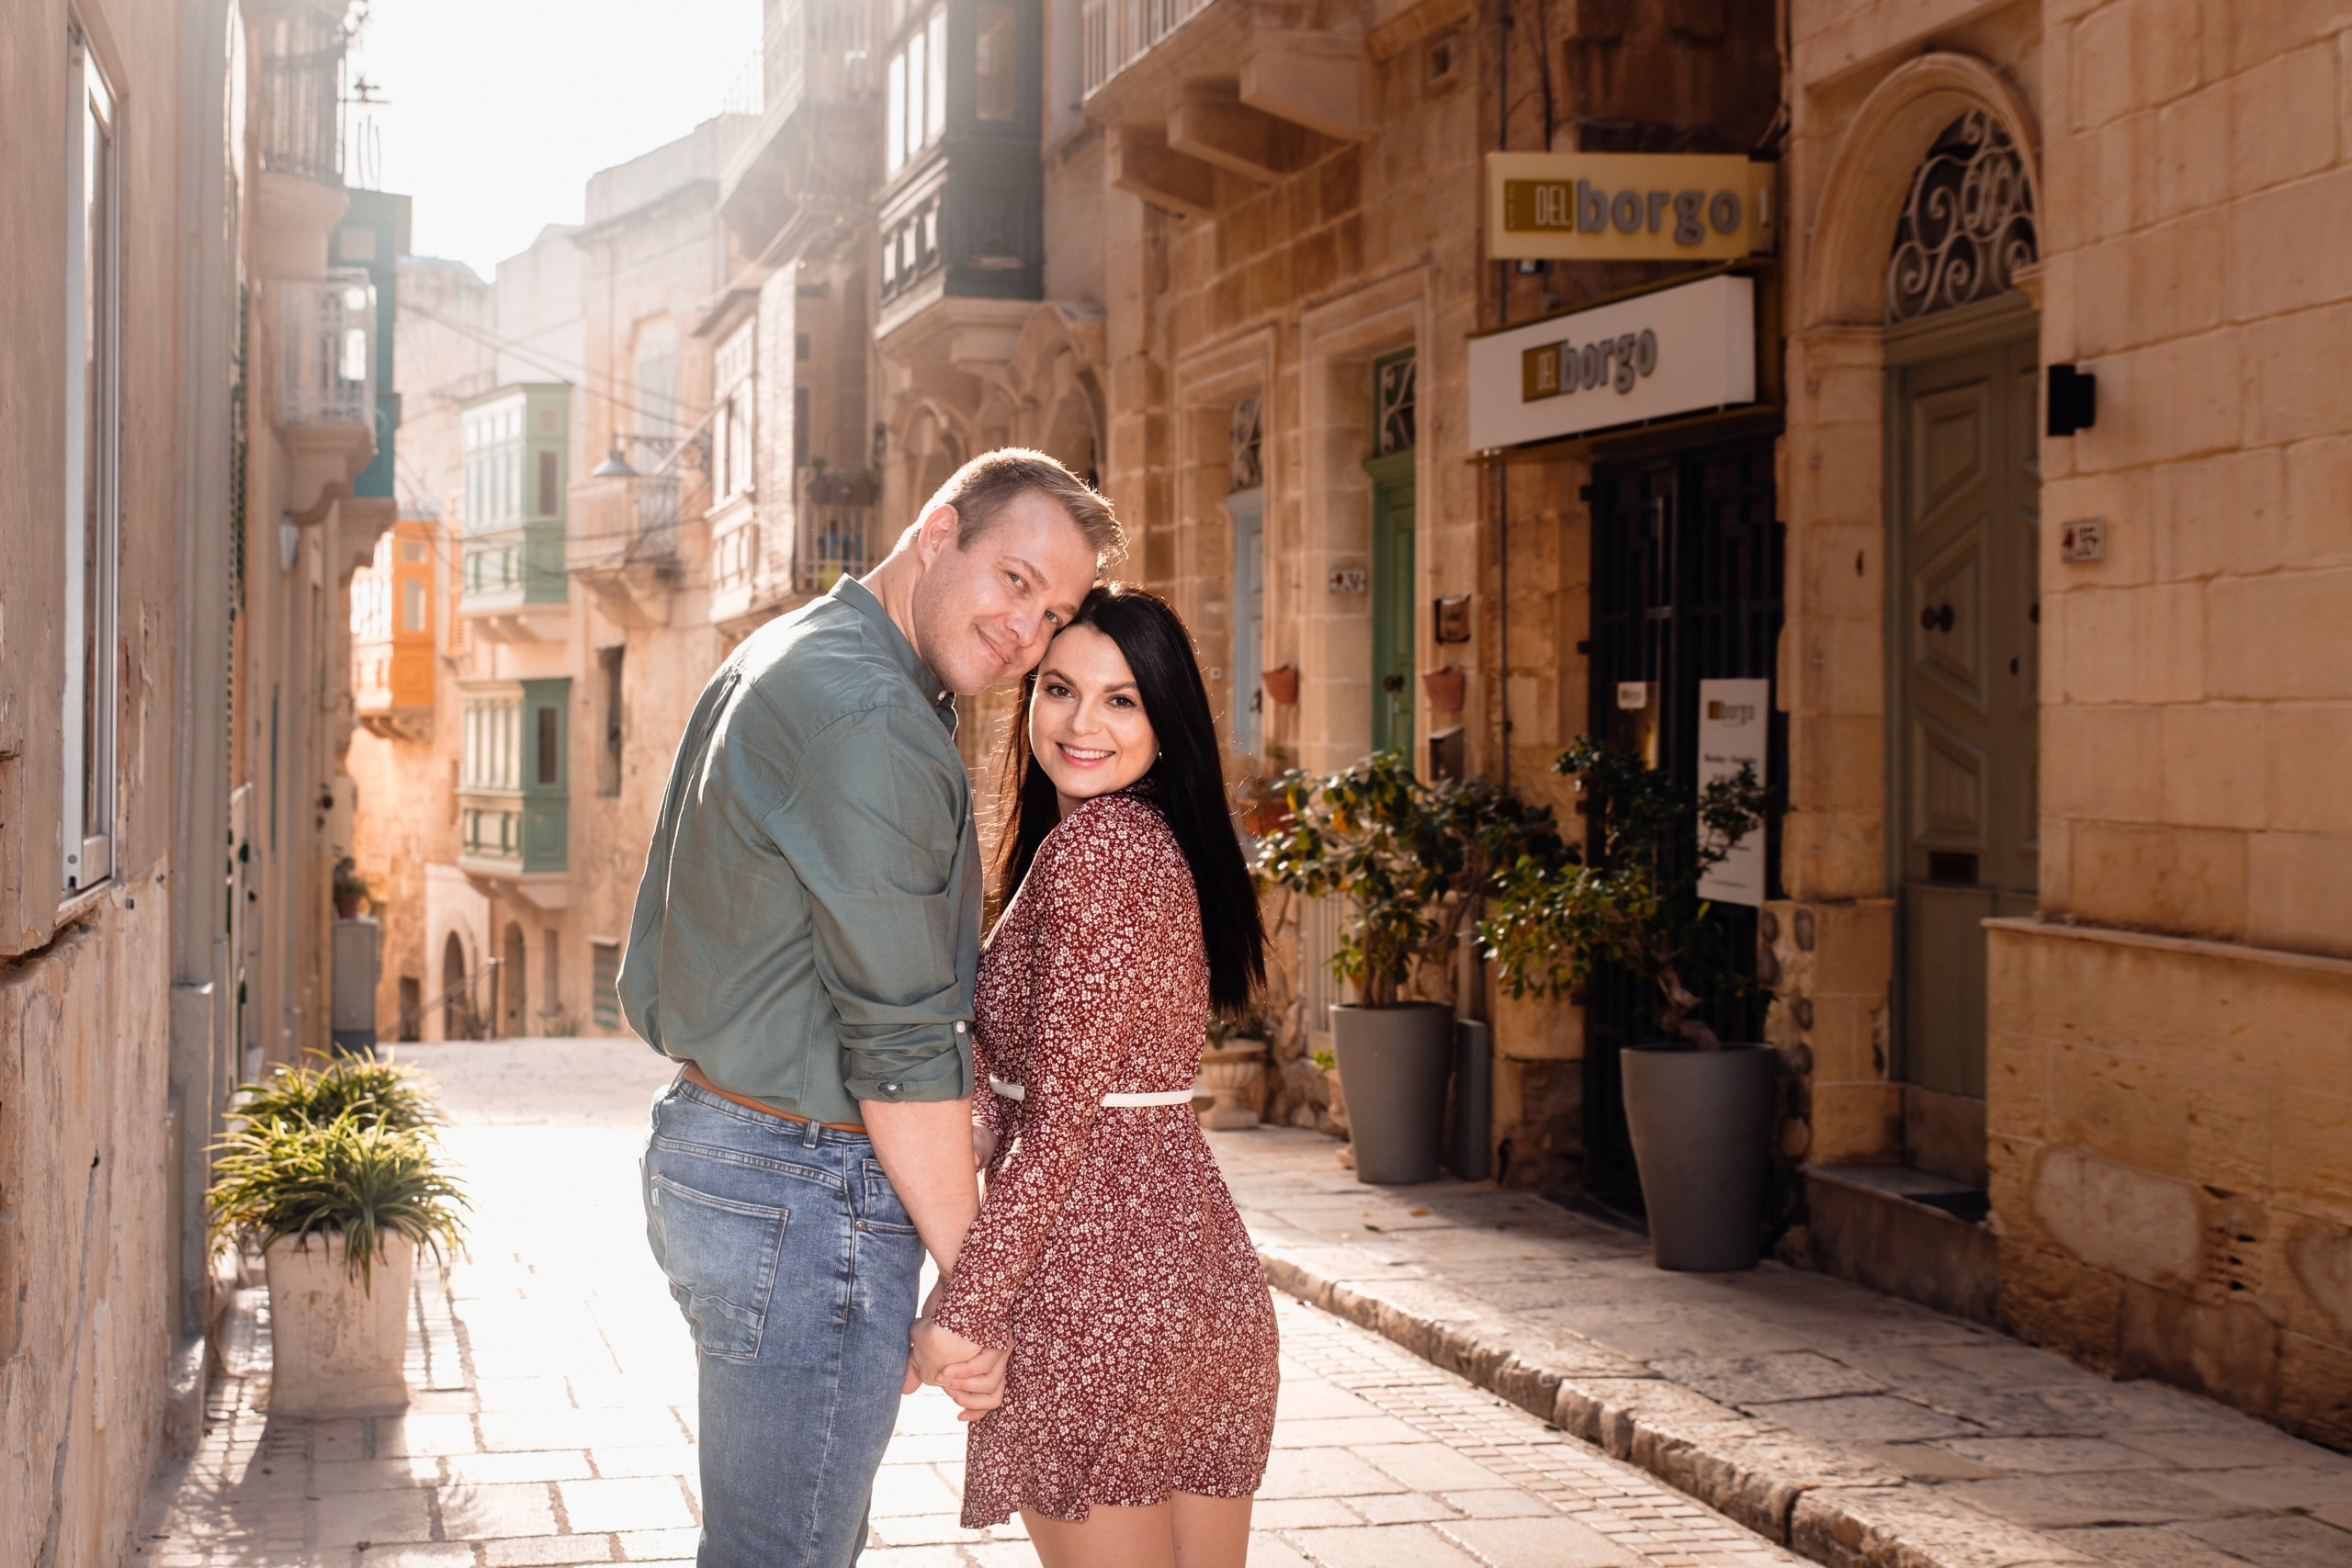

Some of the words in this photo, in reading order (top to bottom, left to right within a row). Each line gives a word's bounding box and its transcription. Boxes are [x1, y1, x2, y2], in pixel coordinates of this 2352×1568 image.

[1535, 185, 1571, 227] DEL
[1577, 178, 1742, 246] borgo
[1559, 328, 1658, 396] borgo
